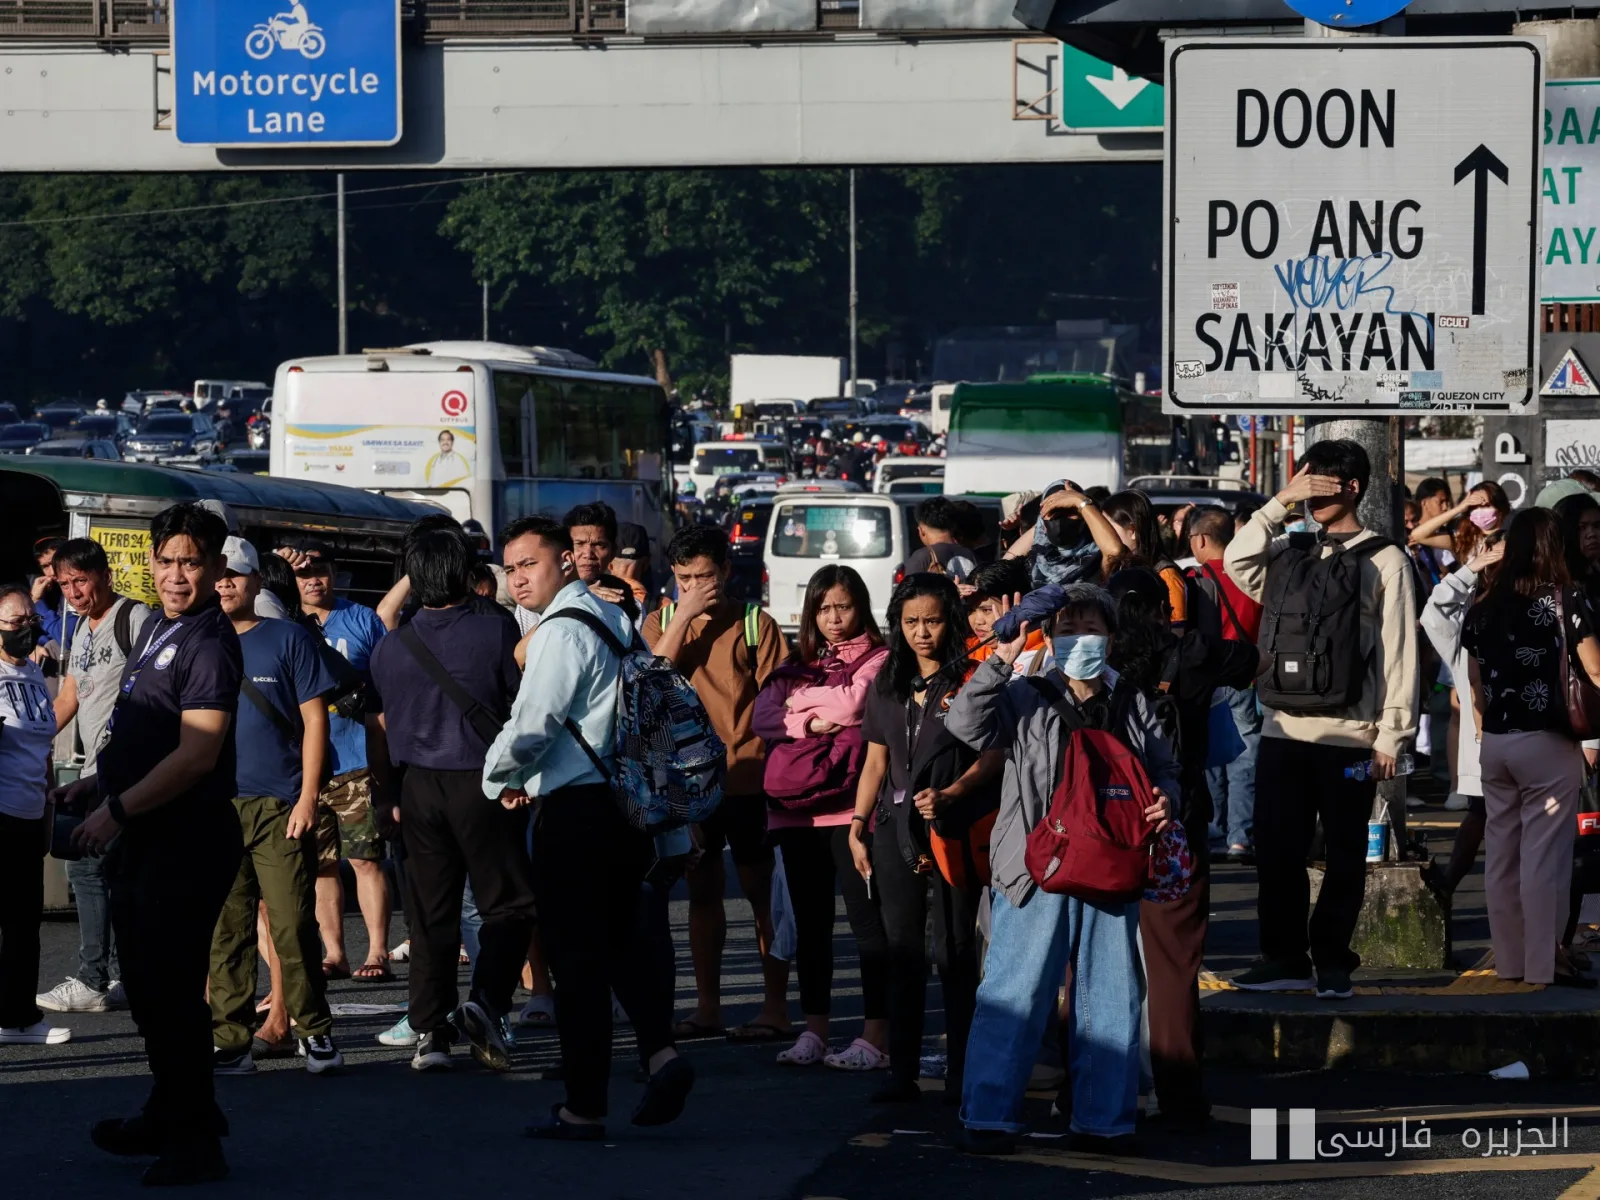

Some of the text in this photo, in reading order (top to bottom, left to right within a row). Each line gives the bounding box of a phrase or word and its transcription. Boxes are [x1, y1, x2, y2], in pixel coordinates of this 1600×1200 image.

[193, 67, 379, 101] Motorcycle
[248, 109, 325, 133] Lane
[1236, 88, 1395, 148] DOON
[1207, 199, 1424, 260] PO ANG
[1545, 227, 1600, 265] AY
[1440, 316, 1469, 328] GCULT
[1195, 312, 1435, 371] SAKAYAN
[1437, 392, 1480, 401] QUEZON
[1482, 392, 1505, 401] CITY
